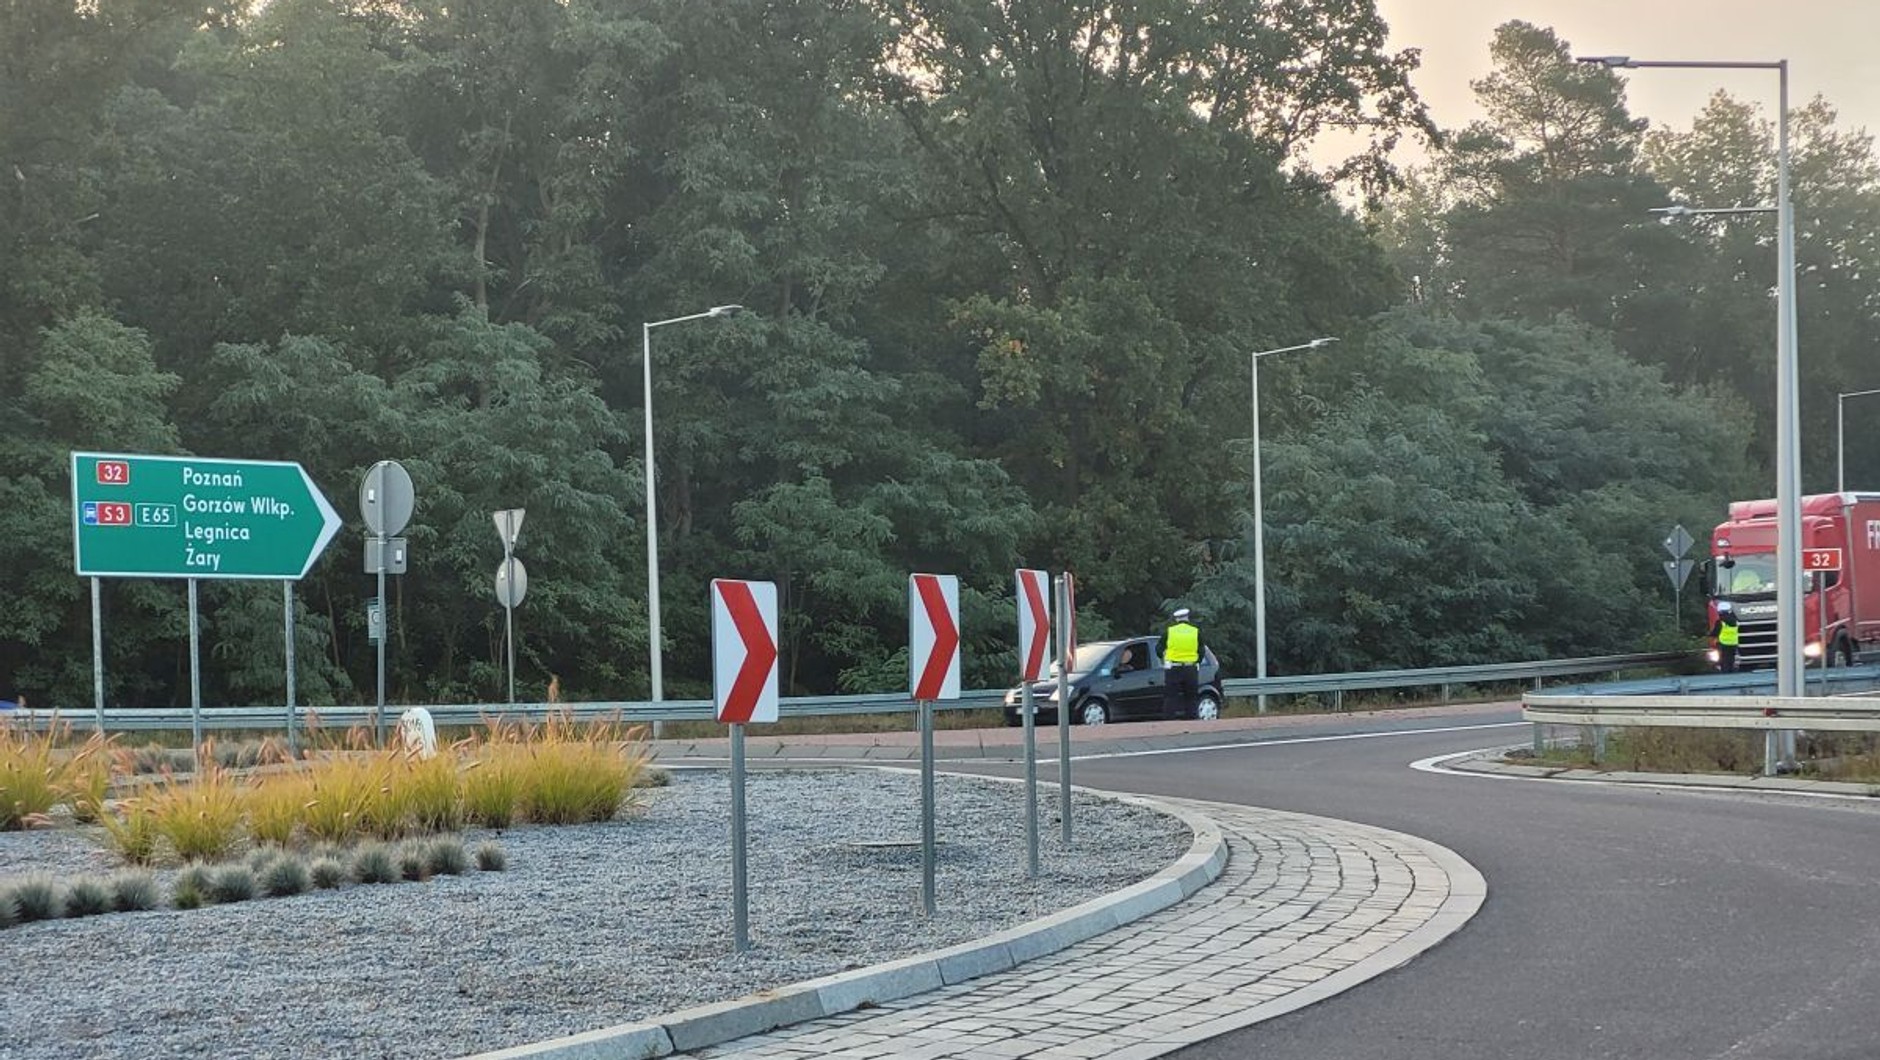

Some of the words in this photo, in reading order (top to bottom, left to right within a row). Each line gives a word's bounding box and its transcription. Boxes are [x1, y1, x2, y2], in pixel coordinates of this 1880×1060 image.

[104, 465, 122, 481] 32
[183, 467, 242, 487] Poznań
[183, 494, 245, 513] Gorzów
[251, 497, 294, 520] Wlkp.
[185, 521, 250, 544] Legnica
[185, 543, 220, 571] Żary
[1812, 553, 1830, 567] 32
